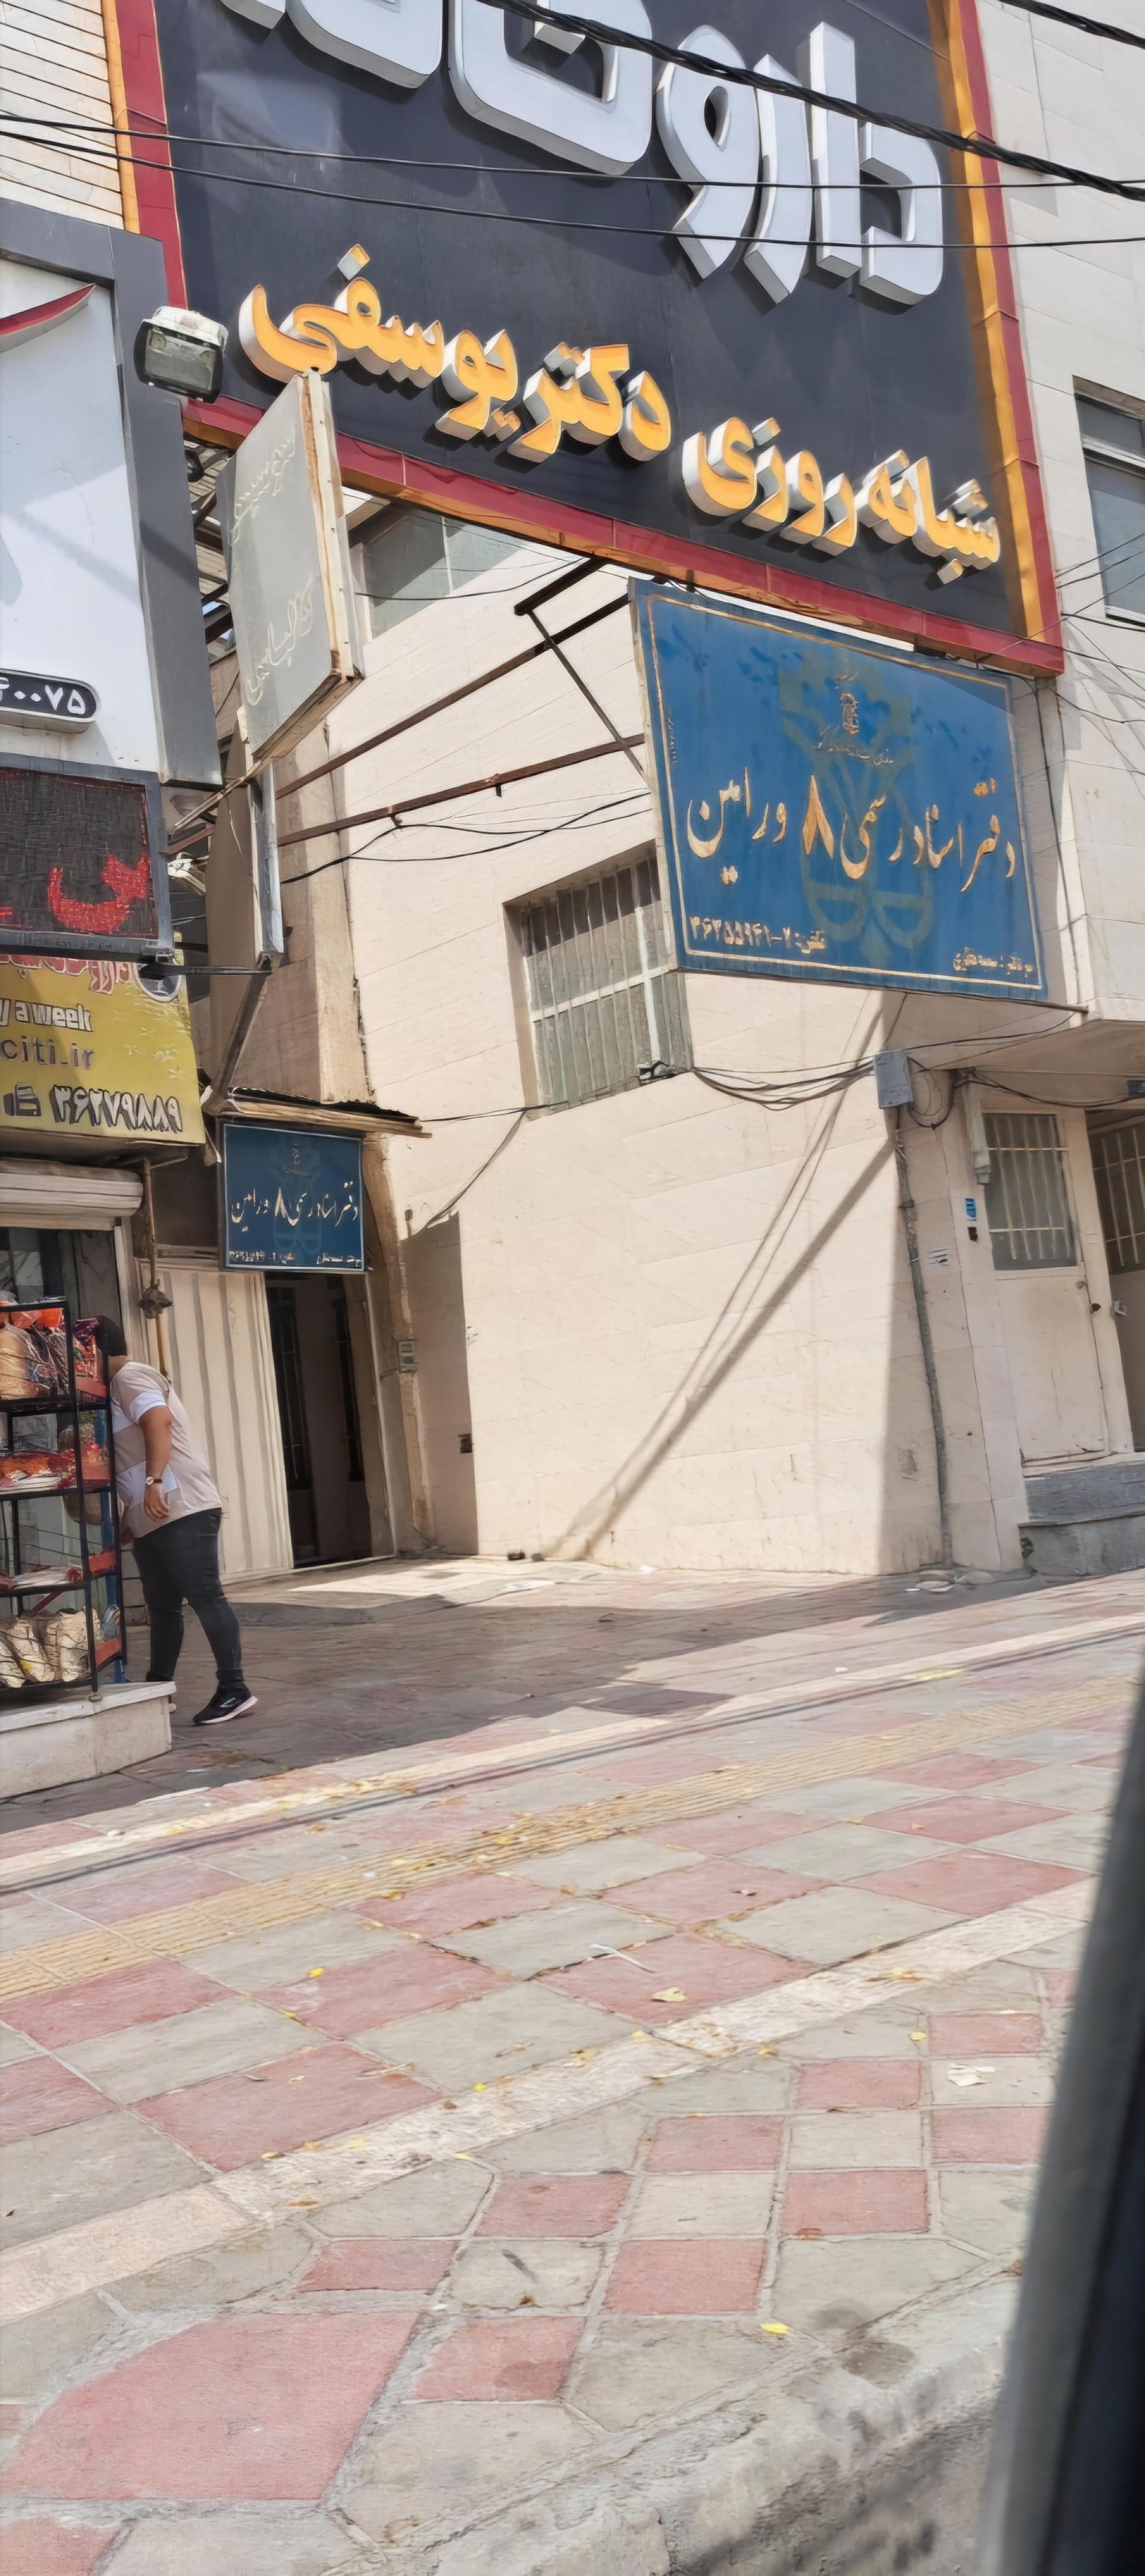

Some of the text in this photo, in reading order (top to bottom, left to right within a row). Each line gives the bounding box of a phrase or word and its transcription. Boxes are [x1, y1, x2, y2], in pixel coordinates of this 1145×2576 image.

[239, 243, 1001, 586] شبانه روزی دکتر یوسفی
[686, 766, 1014, 893] دفتر اسناد رسمی ۸ ورامین
[16, 999, 30, 1023] a
[32, 1002, 94, 1032] week
[274, 1187, 287, 1219] ۸
